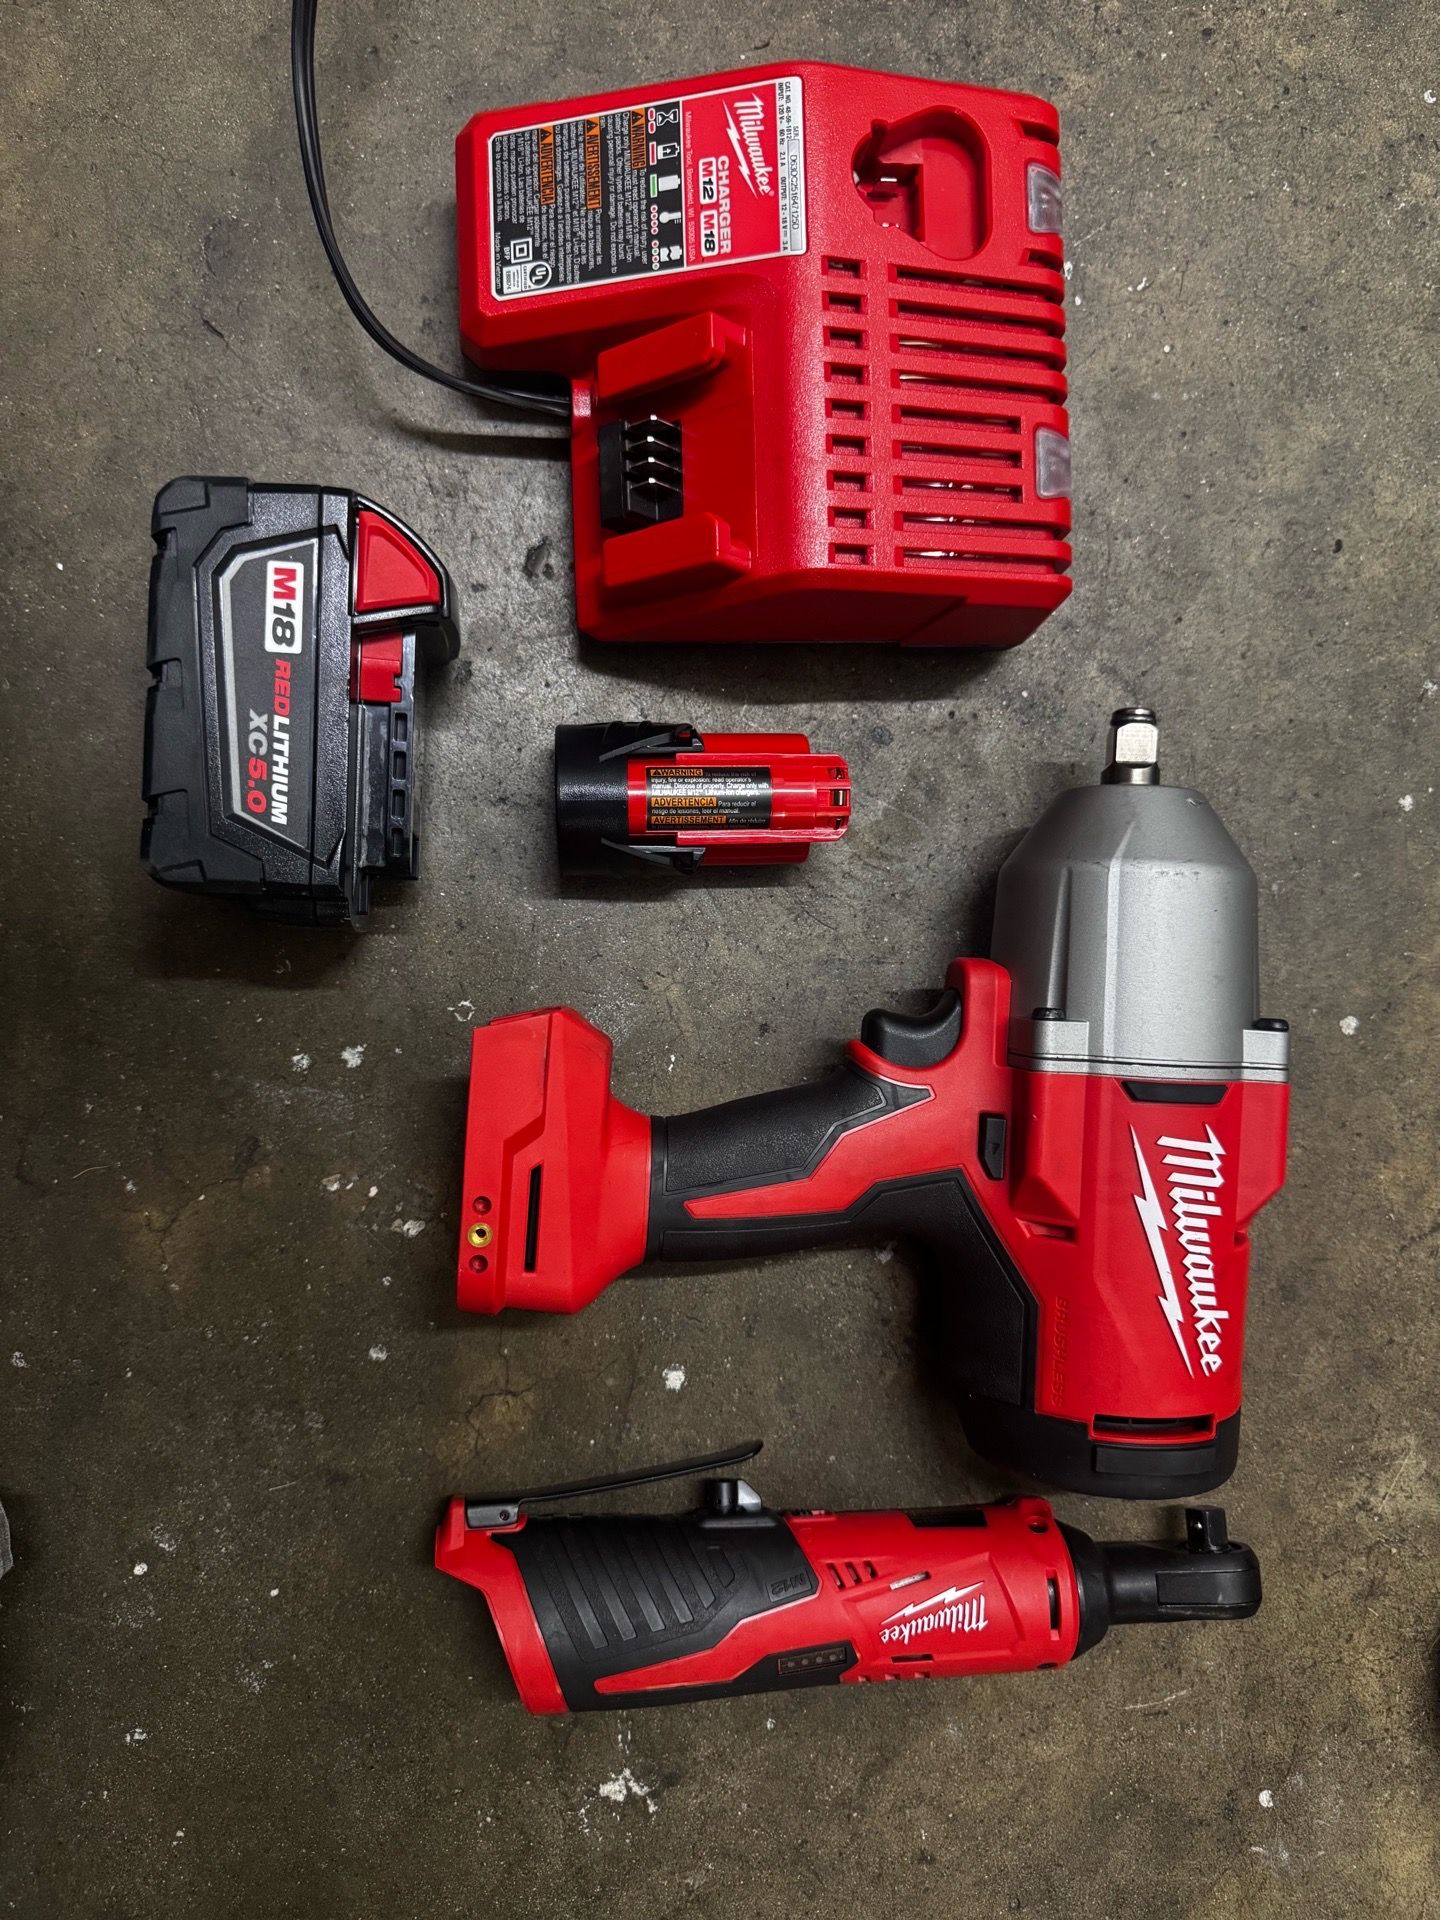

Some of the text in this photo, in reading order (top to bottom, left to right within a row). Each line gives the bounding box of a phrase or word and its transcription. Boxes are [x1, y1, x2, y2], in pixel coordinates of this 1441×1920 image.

[776, 82, 784, 101] INPUT:
[605, 114, 614, 139] causing
[613, 113, 621, 135] battery
[620, 111, 629, 135] Charge
[684, 111, 693, 148] Milwaukee
[778, 128, 785, 136] 60
[606, 139, 615, 166] personal
[621, 135, 629, 149] only
[631, 123, 646, 167] WARNING
[733, 92, 773, 195] Milwaukee
[779, 137, 785, 145] Hz
[540, 141, 553, 203] ADVERTENCIA
[570, 148, 578, 189] MILWAUKEE
[586, 132, 600, 208] AVERTISSEMENT
[607, 167, 615, 184] injury
[623, 149, 631, 191] MILWAUKEE
[615, 175, 623, 193] types
[779, 176, 787, 201] OUTPUT:
[700, 159, 716, 253] M12 M18
[715, 154, 733, 254] CHARGER
[780, 202, 787, 211] 12
[578, 217, 586, 241] charger
[609, 220, 616, 231] Do
[624, 211, 632, 224] and
[781, 216, 788, 224] 18
[688, 244, 696, 262] USA
[530, 266, 547, 283] UL
[271, 566, 298, 648] M18
[270, 658, 292, 826] REDLITHIUM
[246, 707, 269, 815] XC5.0
[653, 798, 715, 806] ADVERTENCIA
[654, 816, 724, 824] AVERTISSEMENT
[1156, 1123, 1228, 1377] Milwaukee
[1052, 1296, 1071, 1406] BRUSHLESS
[879, 1593, 988, 1645] Milwaukee
